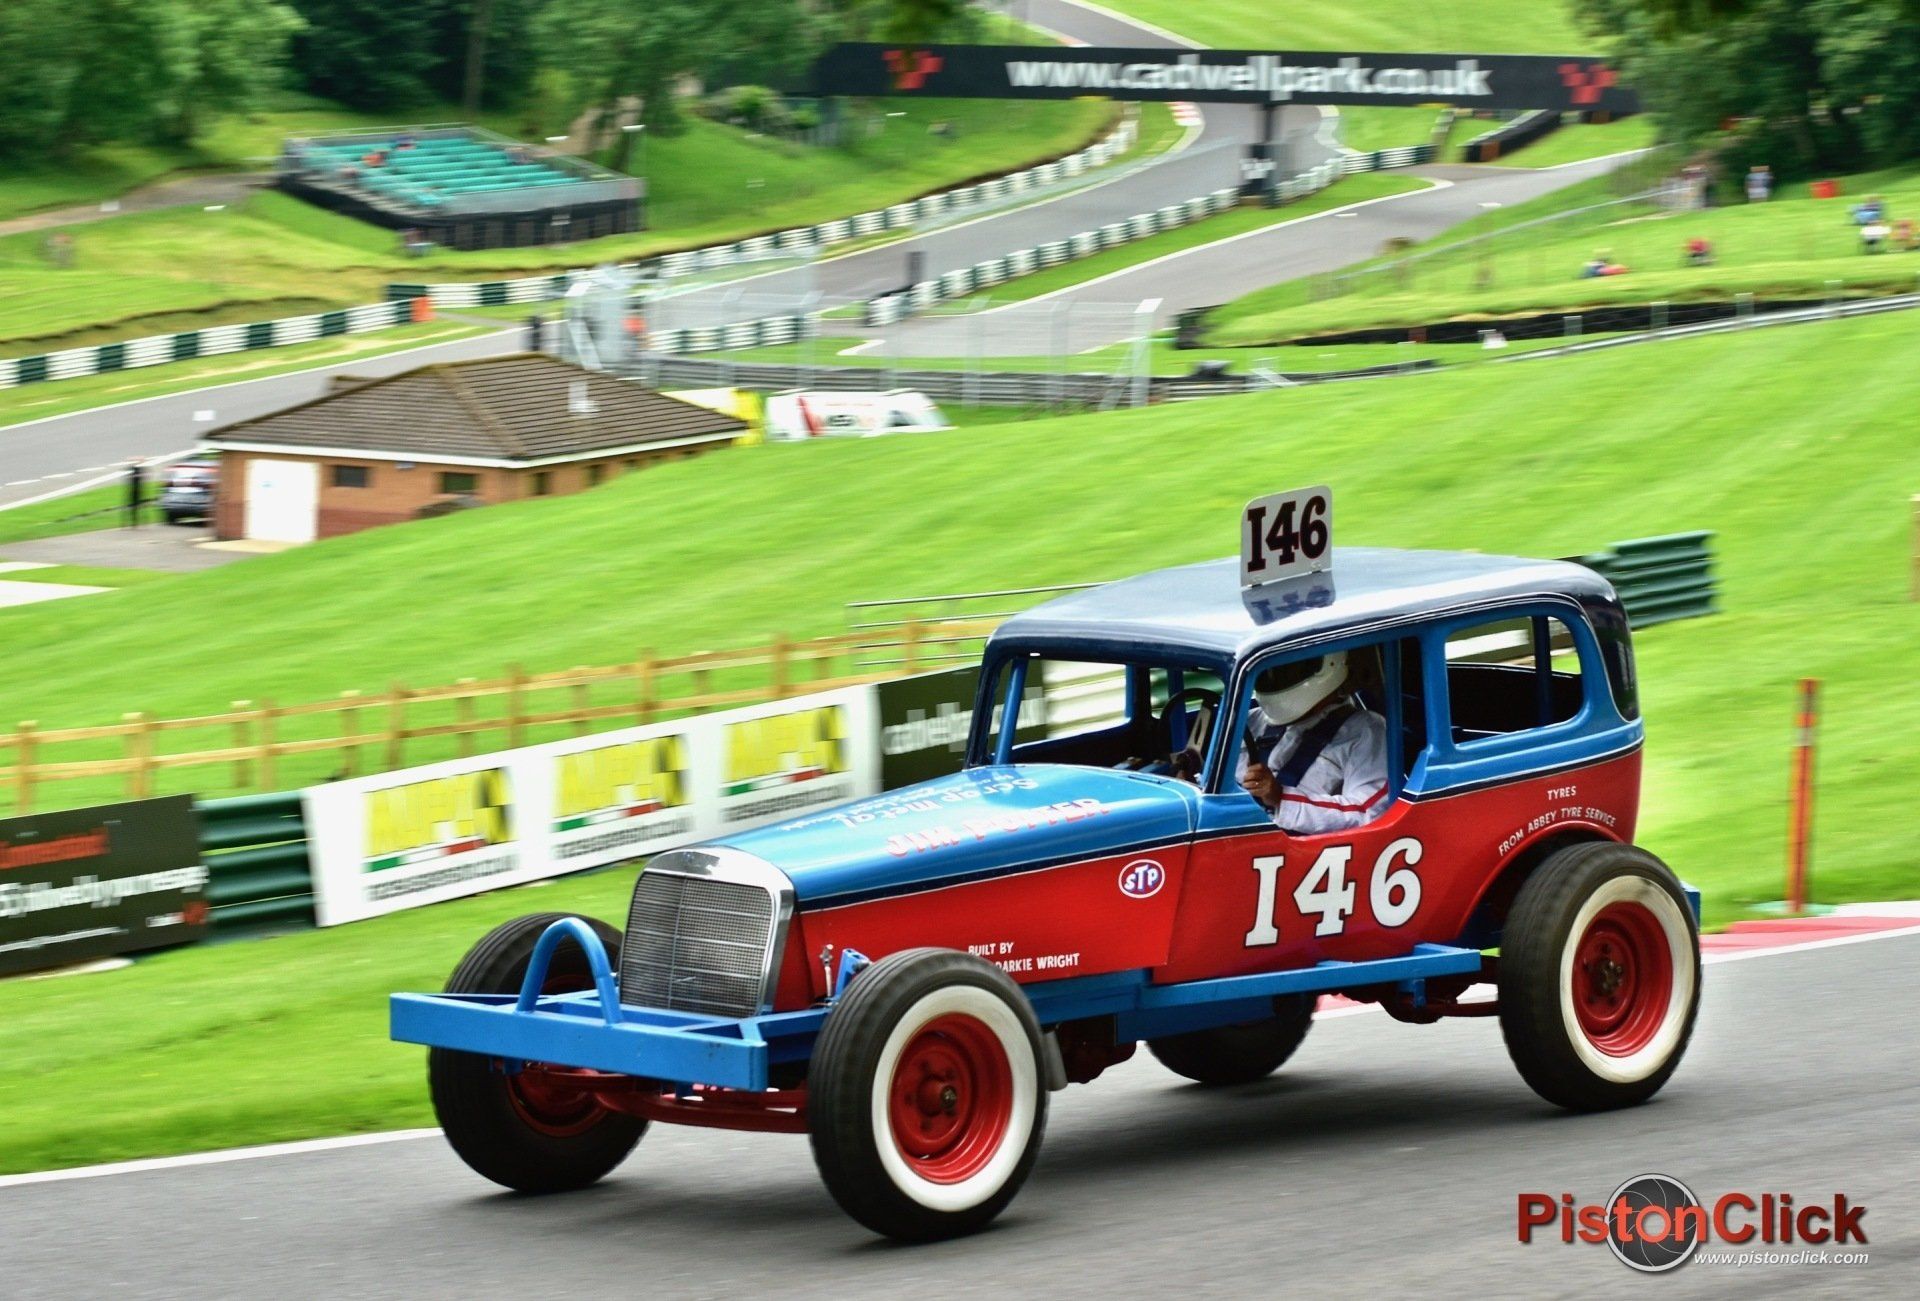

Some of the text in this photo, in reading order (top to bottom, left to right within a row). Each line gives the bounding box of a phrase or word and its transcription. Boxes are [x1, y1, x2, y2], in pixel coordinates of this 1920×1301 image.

[1005, 54, 1494, 100] www.cadwellpark.co.uk
[1546, 786, 1577, 800] TYRES
[887, 826, 961, 858] JIM
[1498, 807, 1616, 856] FROM ABBEY TYRE SERVICE
[1123, 864, 1159, 891] STP
[968, 942, 1015, 956] BUILT BY
[1036, 953, 1080, 970] WRIGHT
